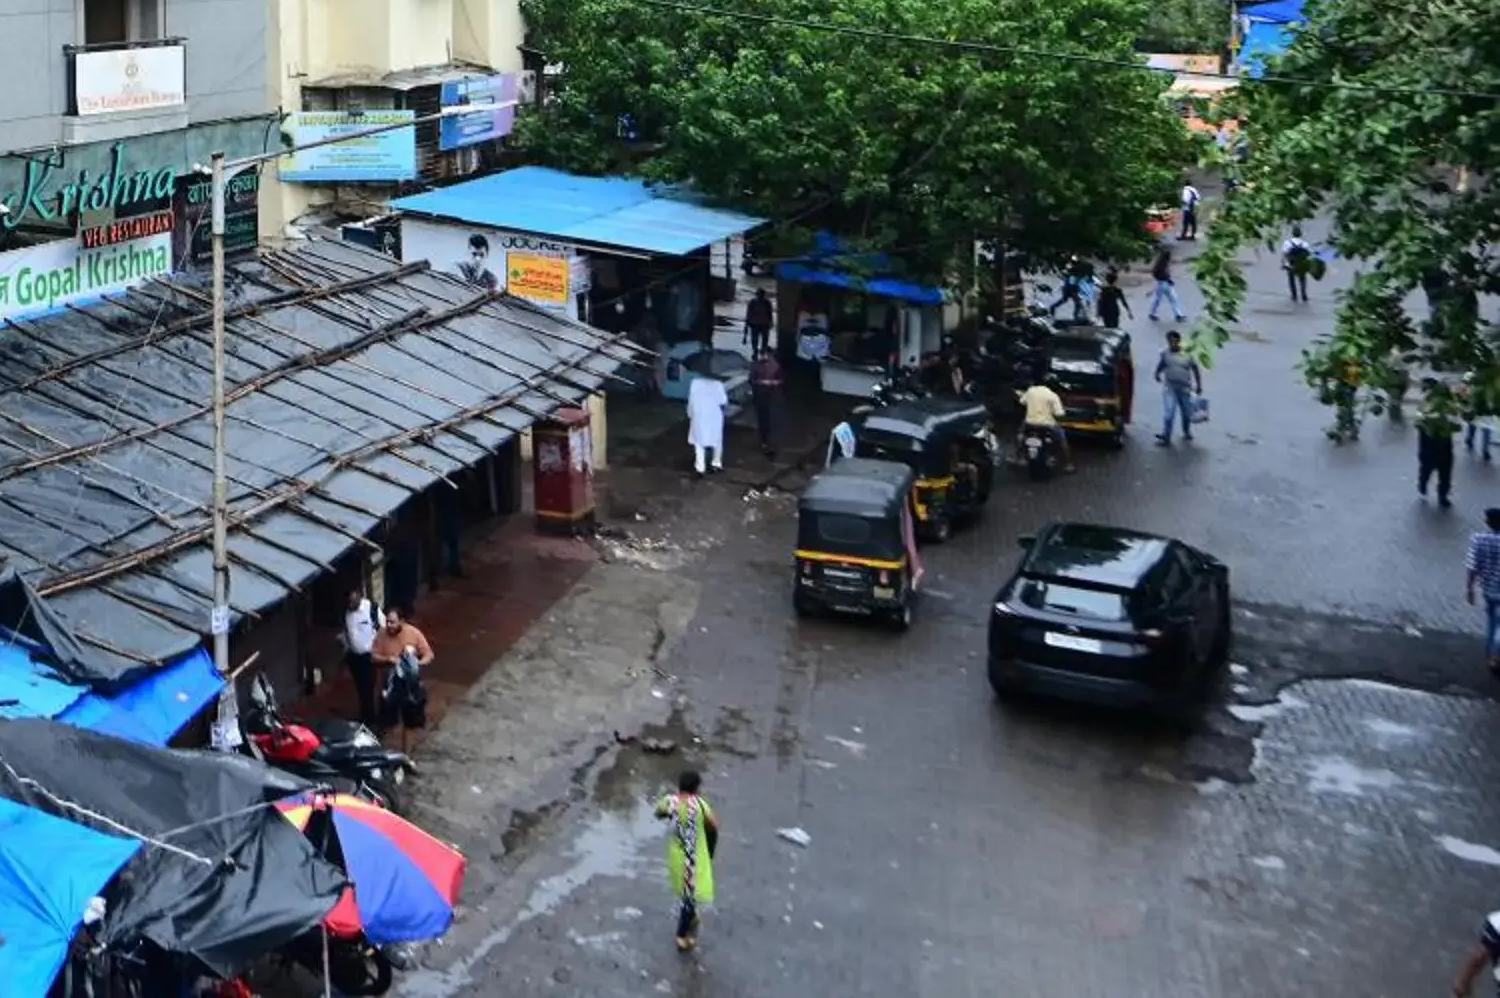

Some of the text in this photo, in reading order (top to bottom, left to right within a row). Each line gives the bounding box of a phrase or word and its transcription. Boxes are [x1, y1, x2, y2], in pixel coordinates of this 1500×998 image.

[3, 141, 177, 228] Krishna
[15, 255, 81, 308] Gopal
[87, 244, 168, 289] Krishna
